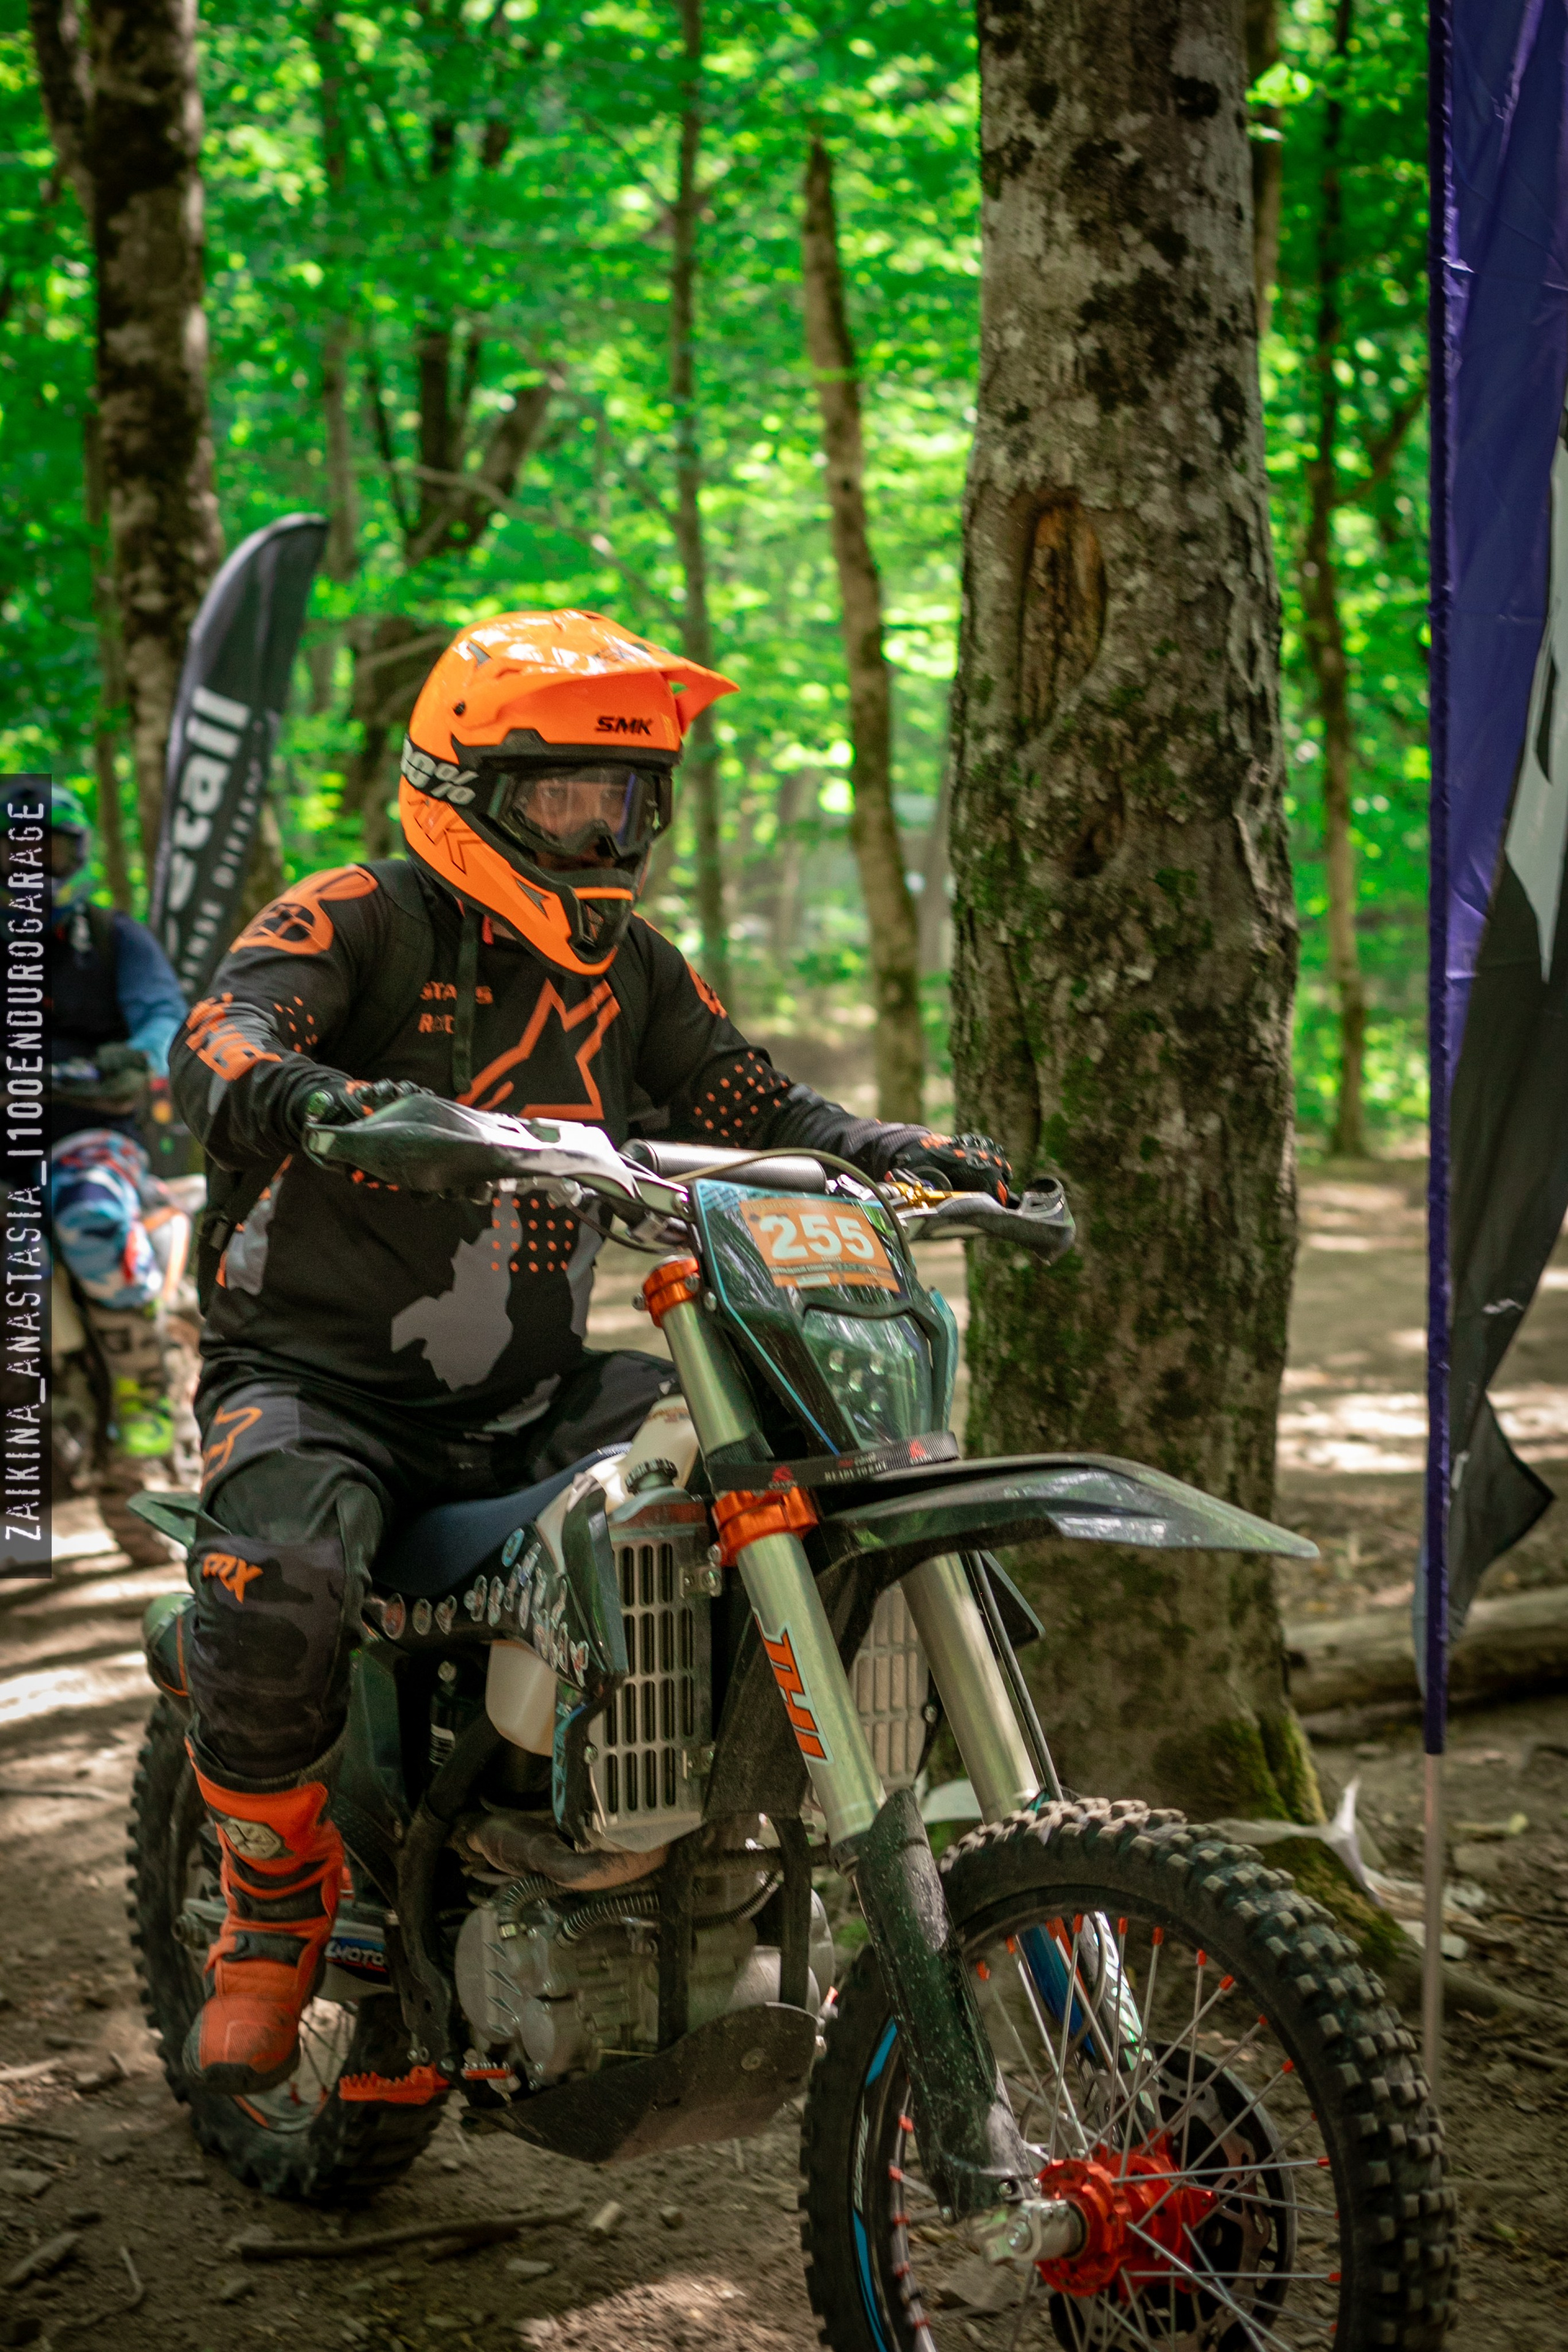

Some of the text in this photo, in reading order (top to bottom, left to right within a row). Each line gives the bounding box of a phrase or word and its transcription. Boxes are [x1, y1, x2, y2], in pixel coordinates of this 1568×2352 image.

[594, 715, 654, 736] SMK
[419, 981, 494, 1005] STAS
[760, 1213, 875, 1261] 255
